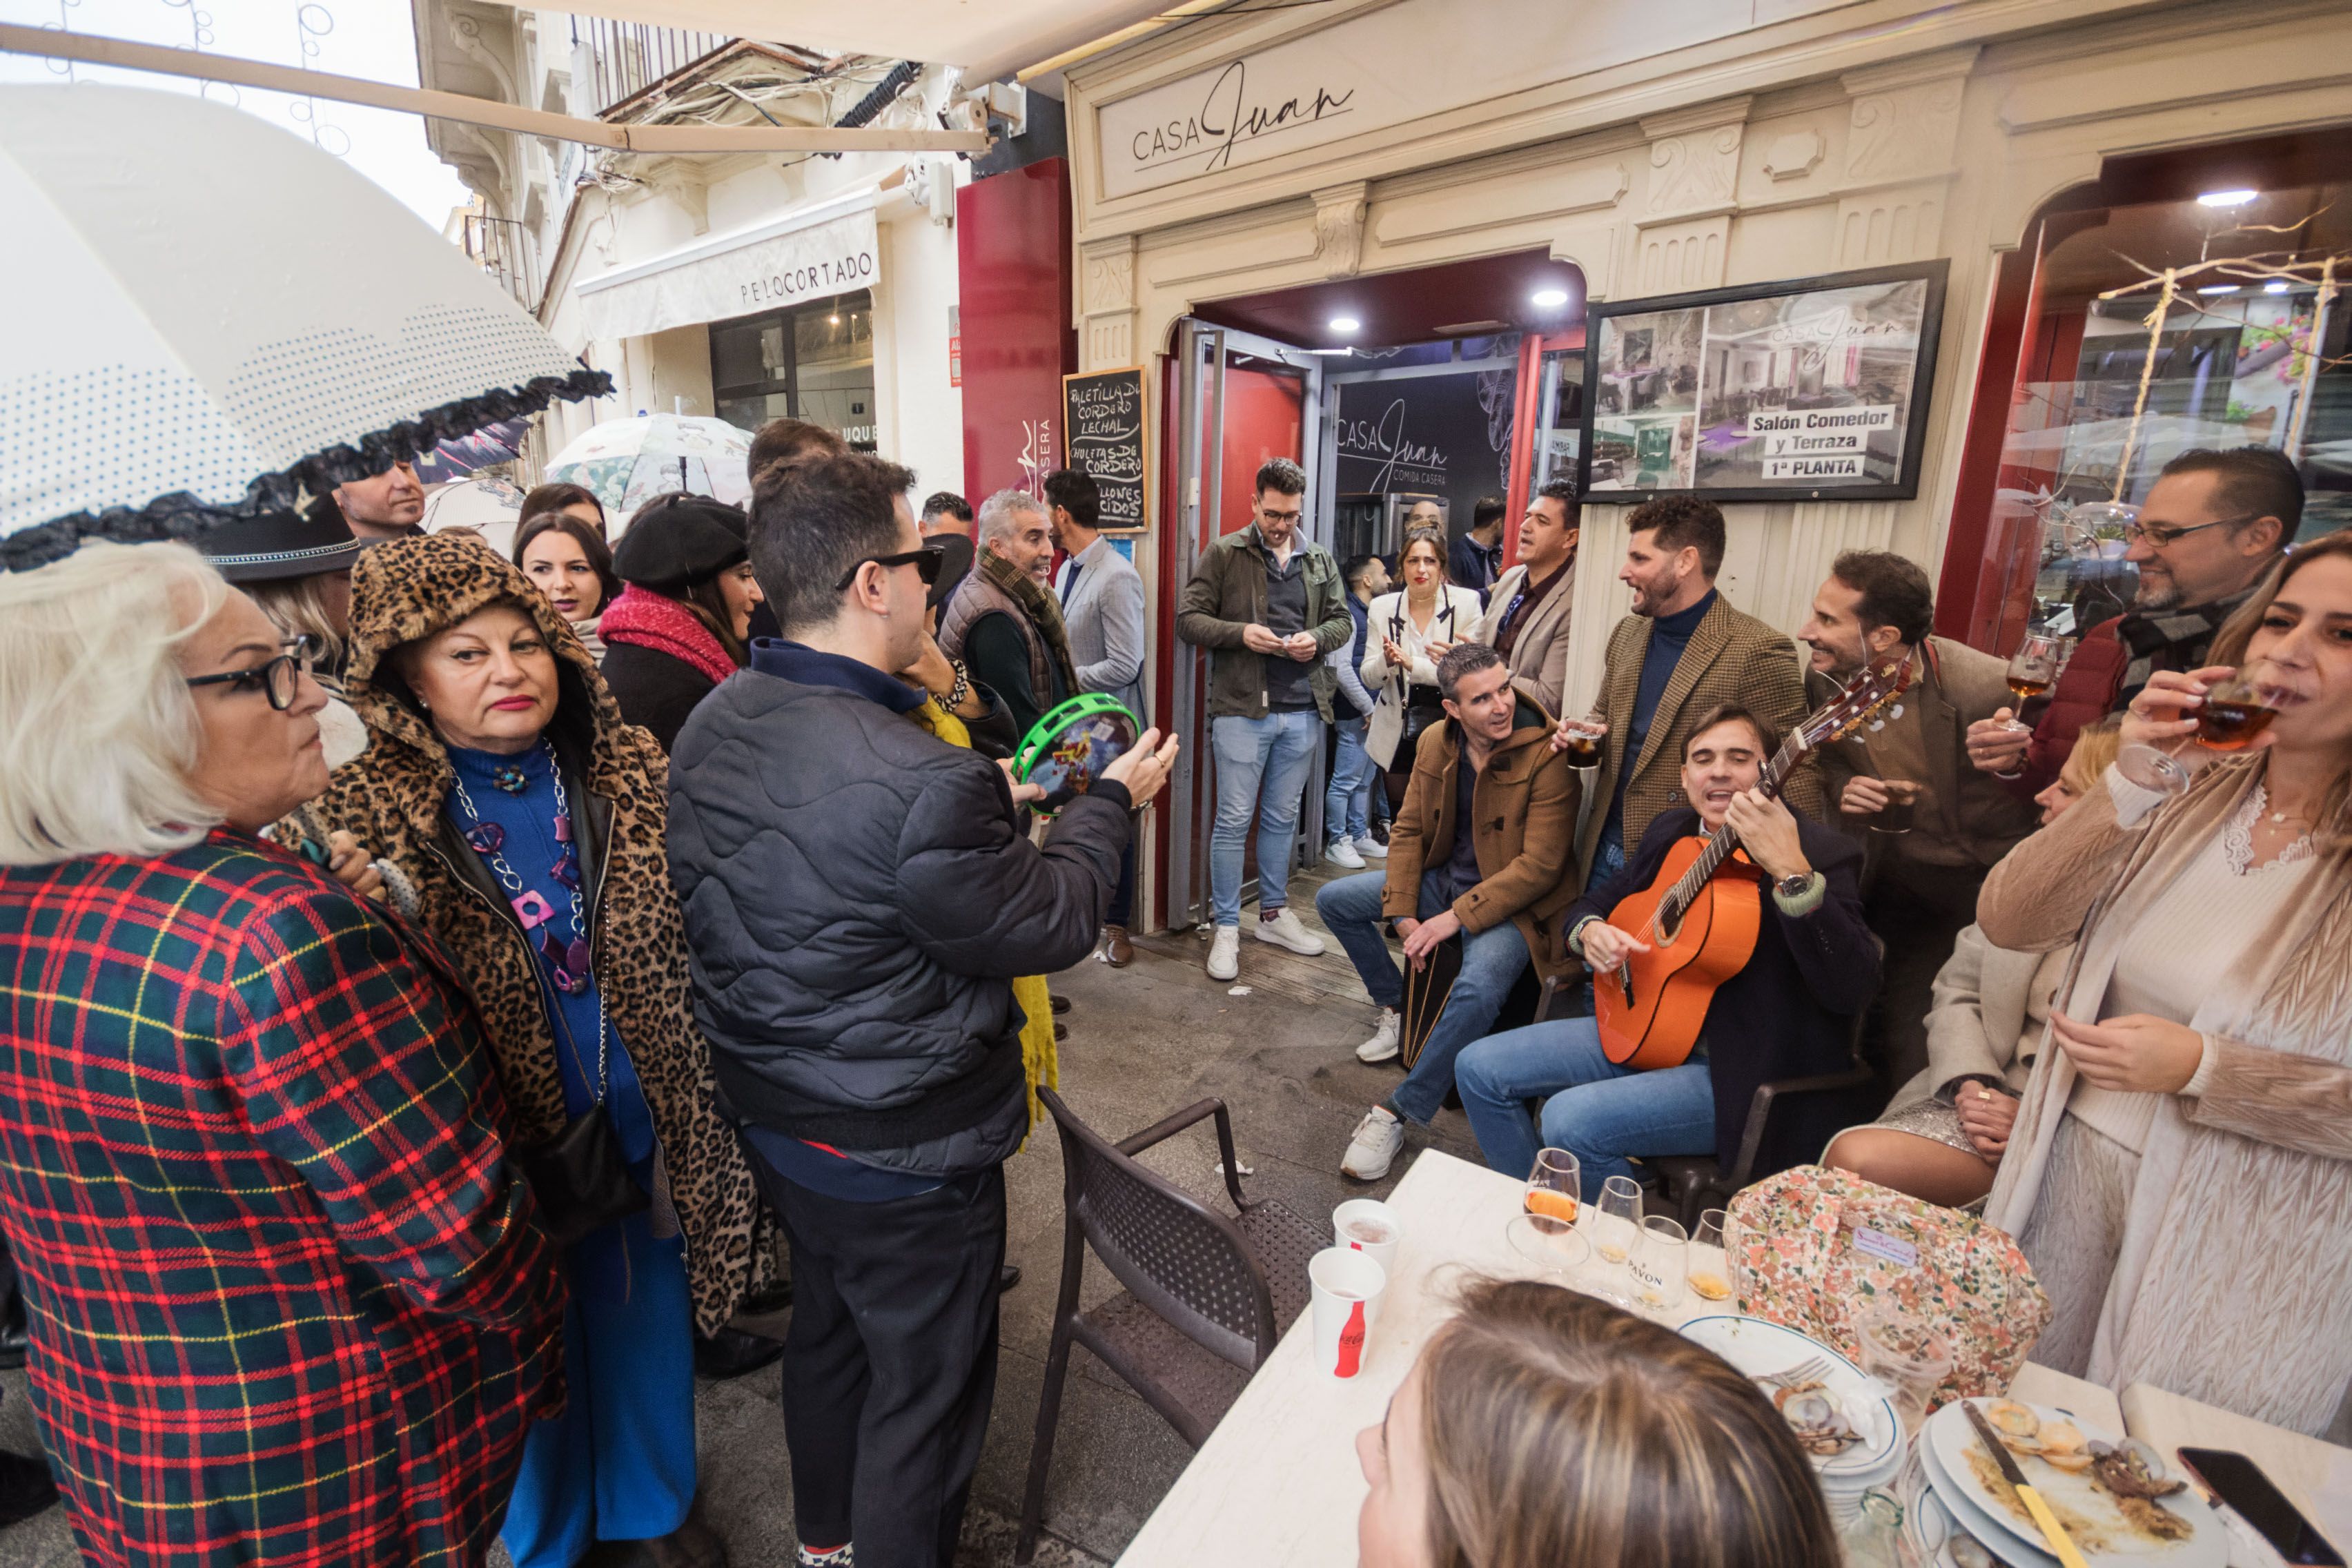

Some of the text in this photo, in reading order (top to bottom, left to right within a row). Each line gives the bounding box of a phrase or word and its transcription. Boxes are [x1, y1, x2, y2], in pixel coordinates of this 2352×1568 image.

[1133, 61, 1353, 170] CASA Juan
[741, 253, 872, 304] PELOCORTADO
[1772, 308, 1904, 371] CASA Juan
[1081, 419, 1130, 434] LECHAL
[1754, 411, 1888, 431] Salón Comedor
[1337, 399, 1447, 494] CASA Juan
[1776, 435, 1856, 453] y Terraza
[1086, 457, 1141, 475] CORDERO
[1793, 460, 1856, 475] PLANTA
[1393, 469, 1446, 486] COMIDA CASERA
[1099, 486, 1141, 504] LLONES
[1099, 498, 1139, 517] CIDOS
[1628, 1260, 1662, 1286] PAVON
